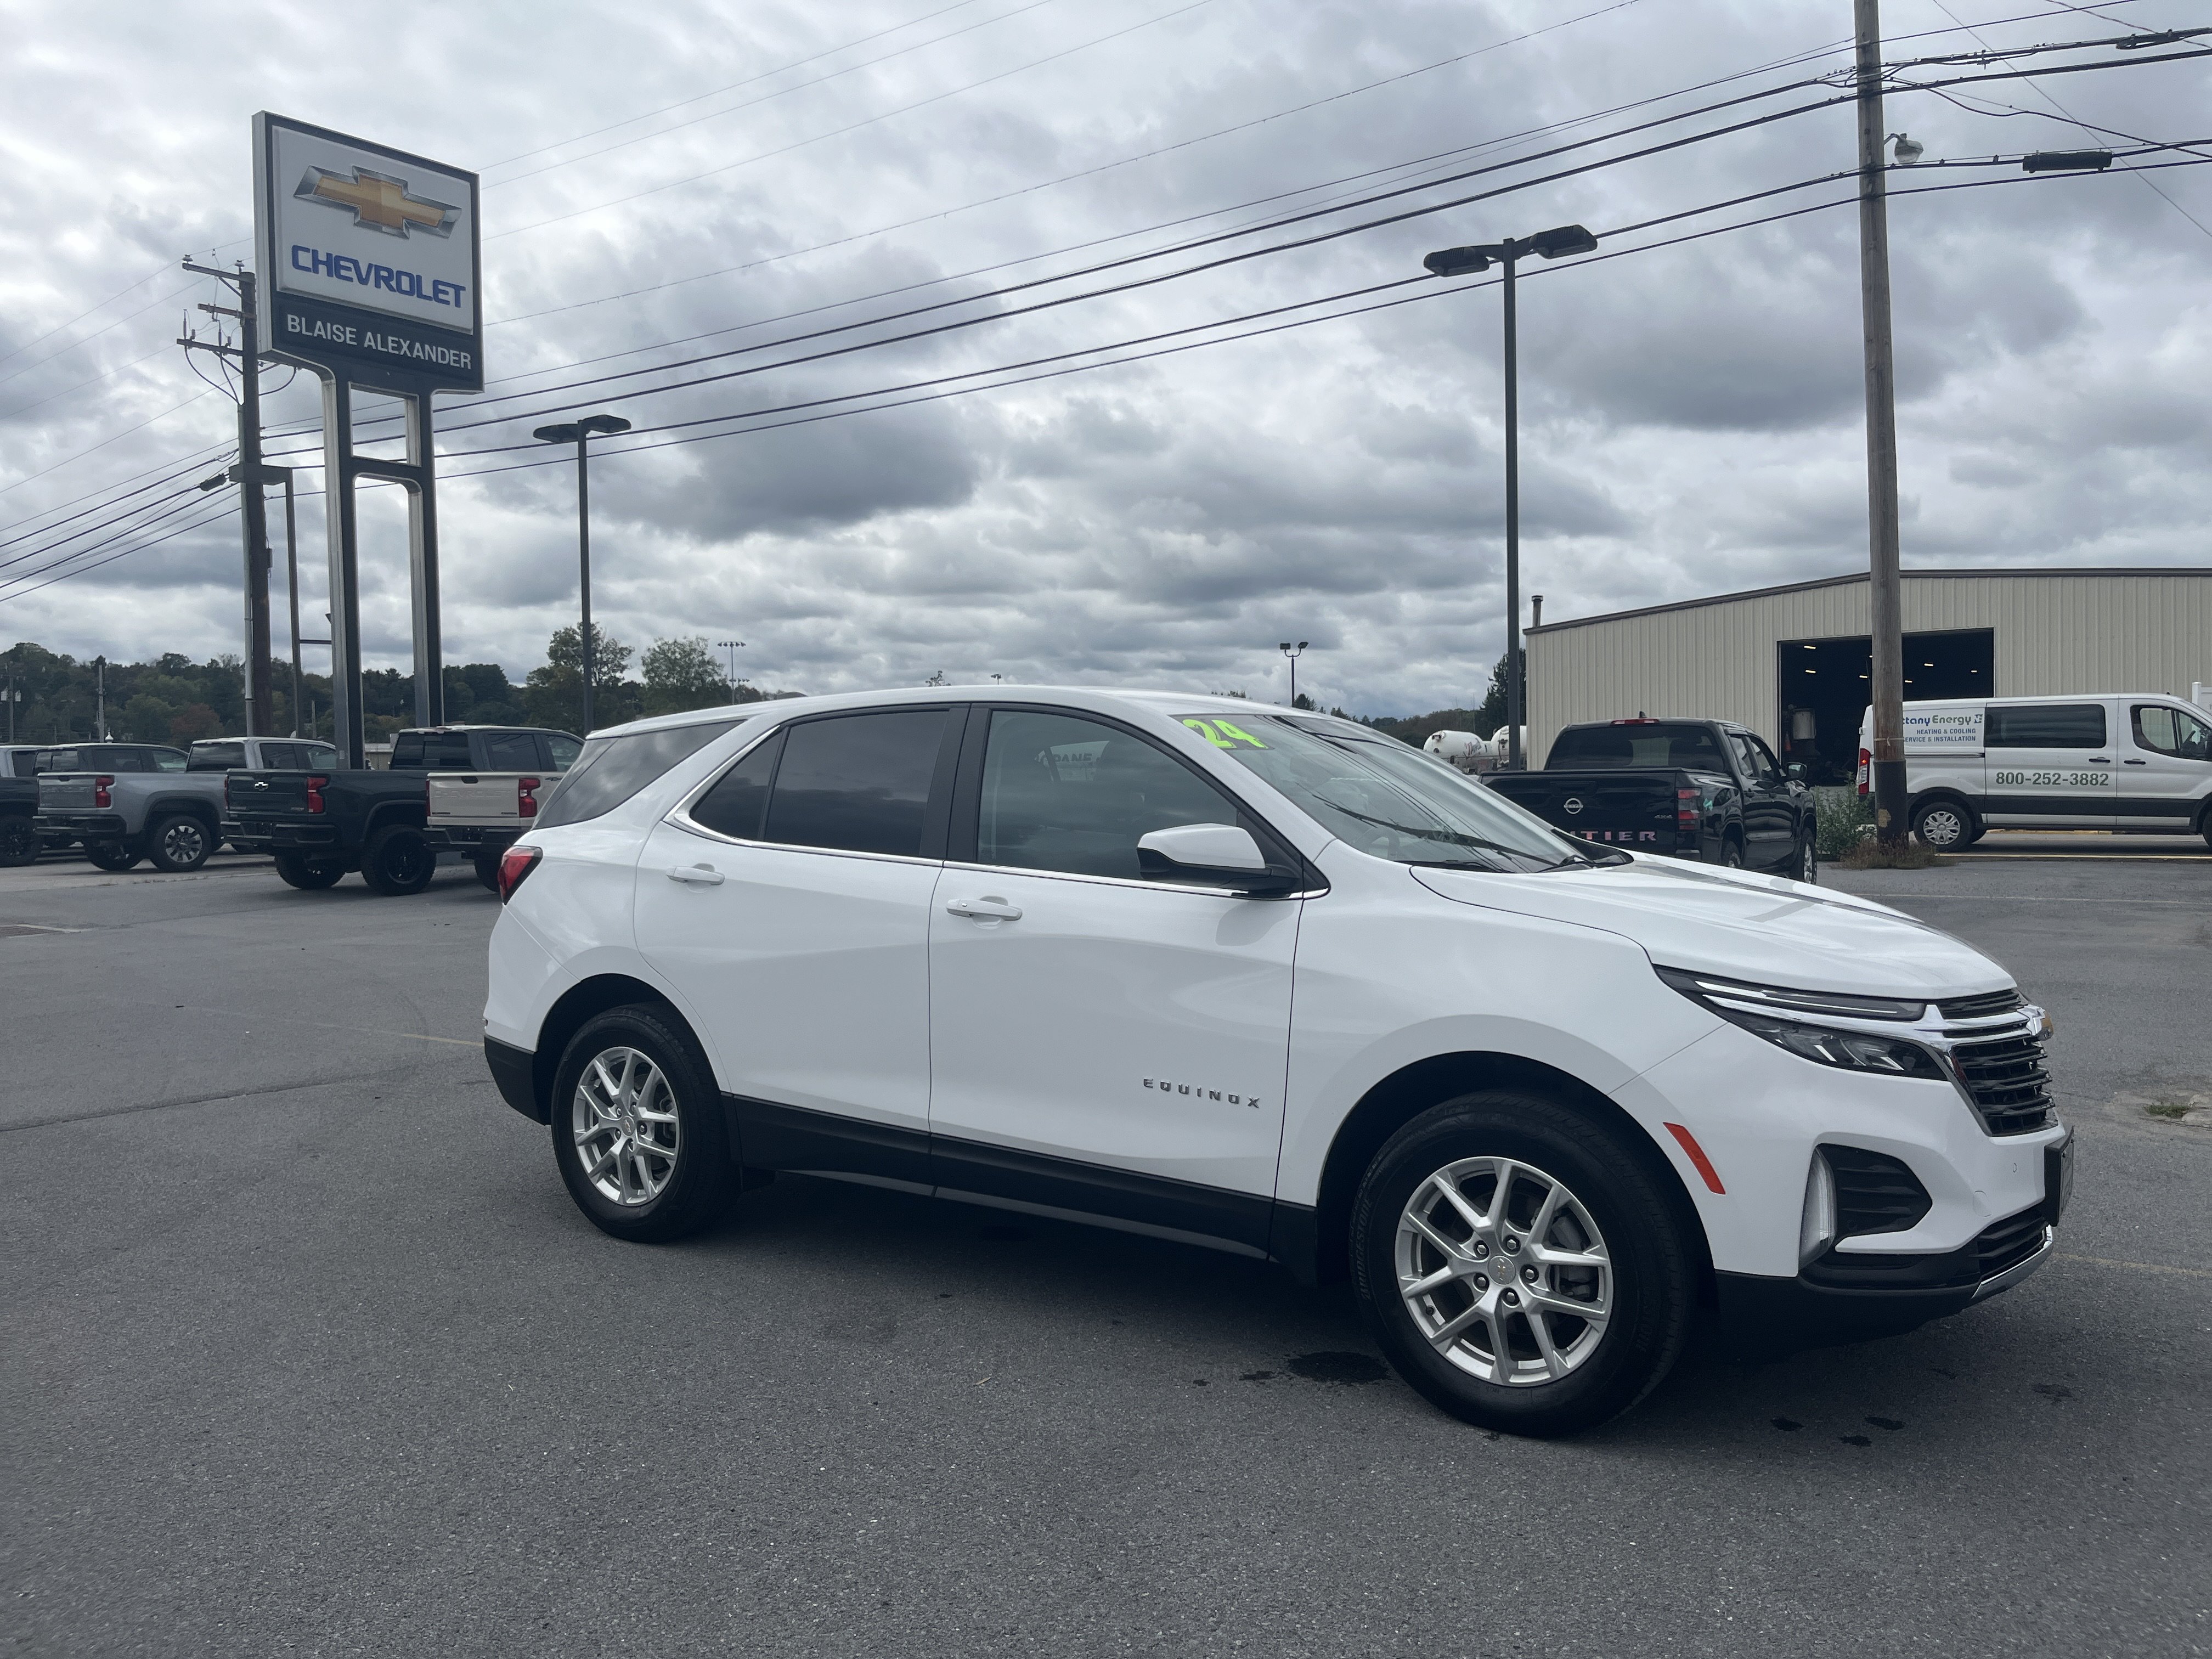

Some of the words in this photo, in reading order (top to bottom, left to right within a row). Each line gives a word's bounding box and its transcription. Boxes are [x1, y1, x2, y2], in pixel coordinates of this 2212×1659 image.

[292, 245, 466, 308] CHEVROLET
[287, 314, 357, 345] BLAISE
[364, 331, 471, 369] ALEXANDER
[1182, 719, 1269, 749] 24
[1932, 715, 1971, 725] Energy
[1996, 772, 2109, 786] 800-252-3882
[1143, 1077, 1260, 1108] EQUINOX
